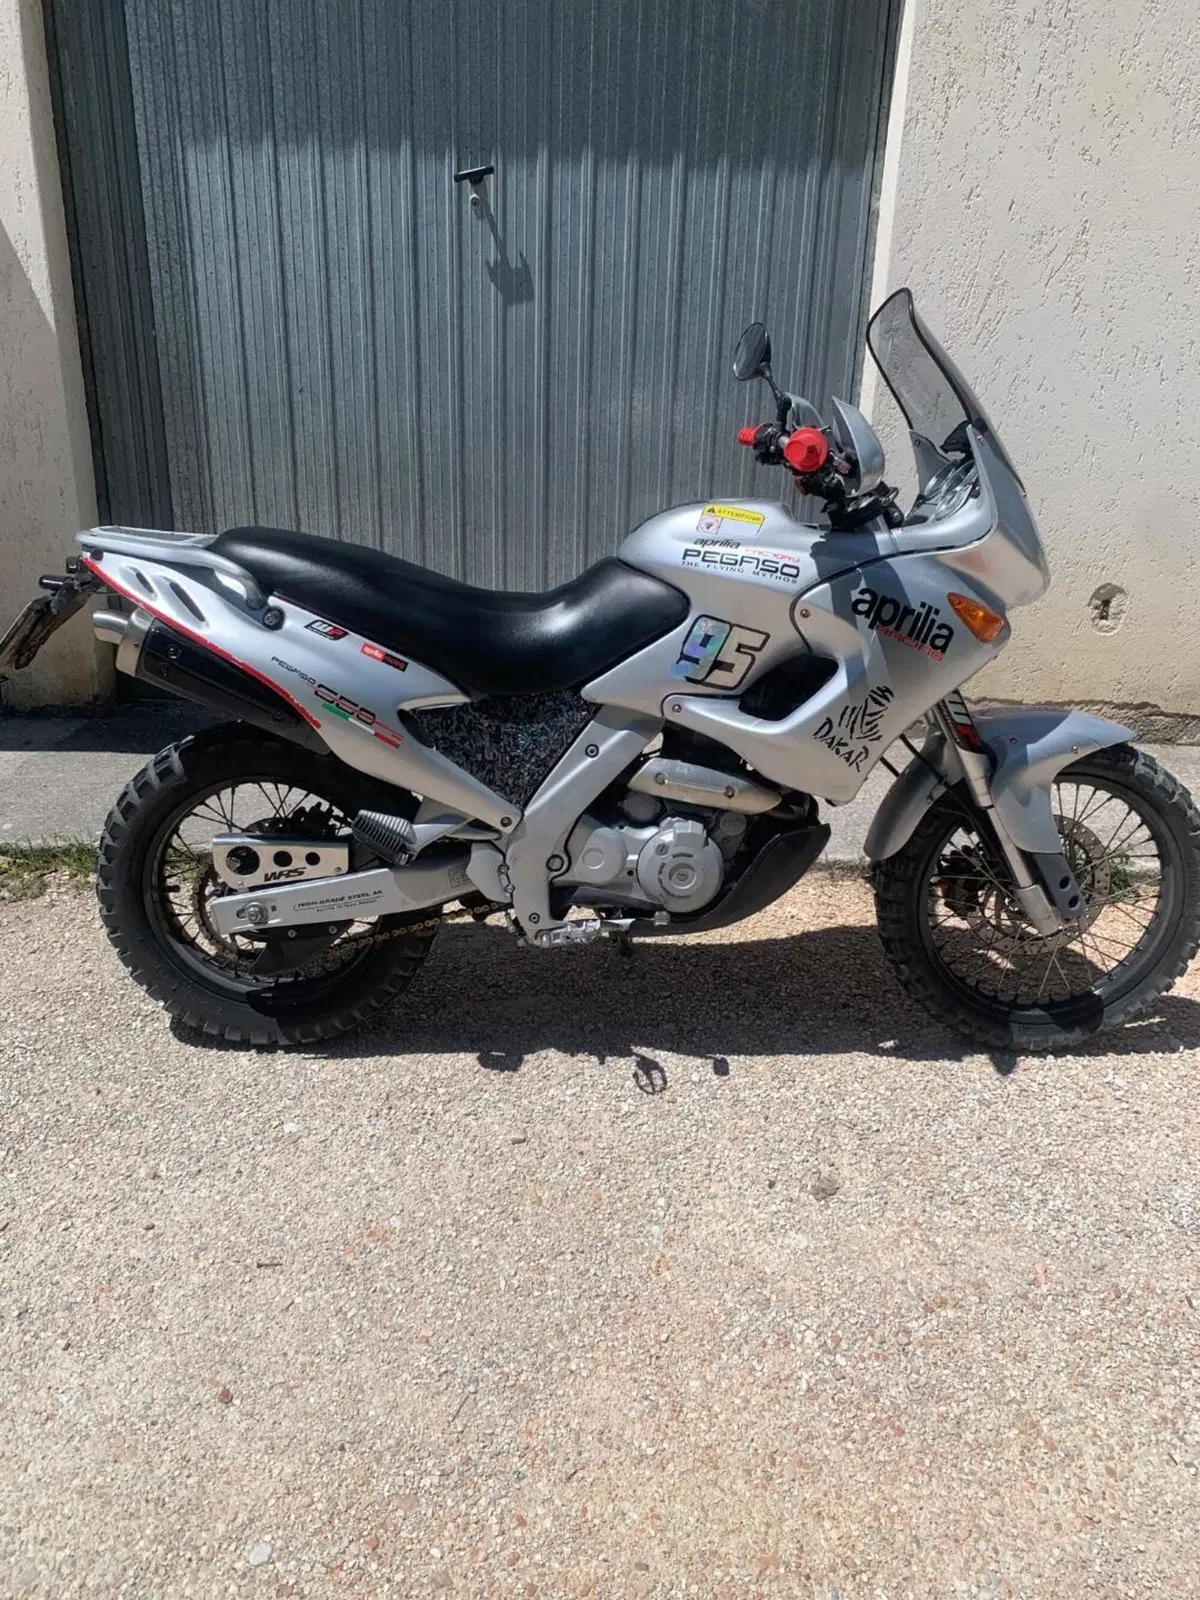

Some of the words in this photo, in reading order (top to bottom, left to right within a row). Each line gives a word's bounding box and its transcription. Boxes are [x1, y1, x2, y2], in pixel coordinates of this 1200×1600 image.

[693, 538, 741, 550] aprilia
[681, 561, 700, 569] THE
[706, 563, 745, 574] FLYING
[751, 570, 798, 585] MYTHOS
[682, 548, 800, 579] PEGASO
[851, 587, 955, 654] aprilia
[271, 656, 316, 685] PEGASO
[813, 716, 870, 773] DAKAR
